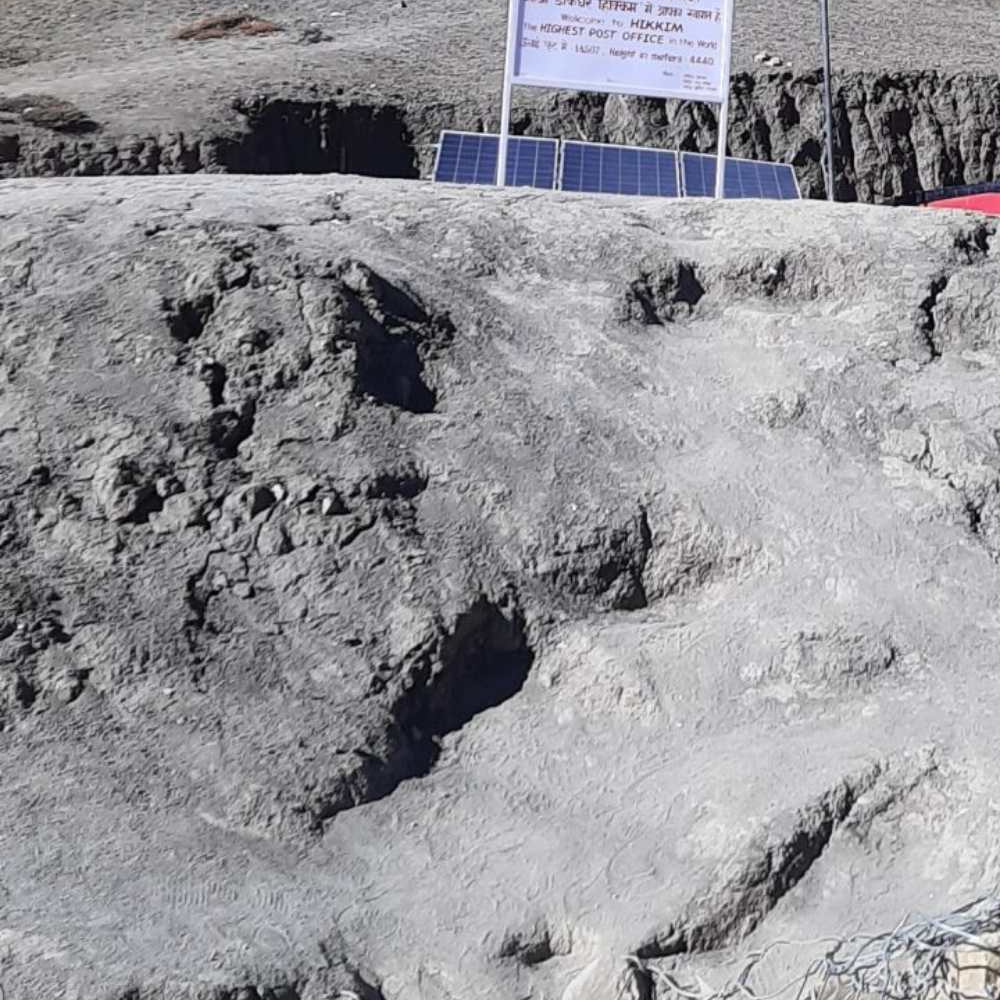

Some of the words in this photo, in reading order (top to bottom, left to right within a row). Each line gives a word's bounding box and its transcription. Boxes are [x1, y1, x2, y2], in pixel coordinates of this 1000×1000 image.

[540, 23, 585, 37] HIGHEST
[588, 27, 618, 40] POST
[622, 31, 665, 45] OFFICE
[630, 18, 684, 33] HIKKIM
